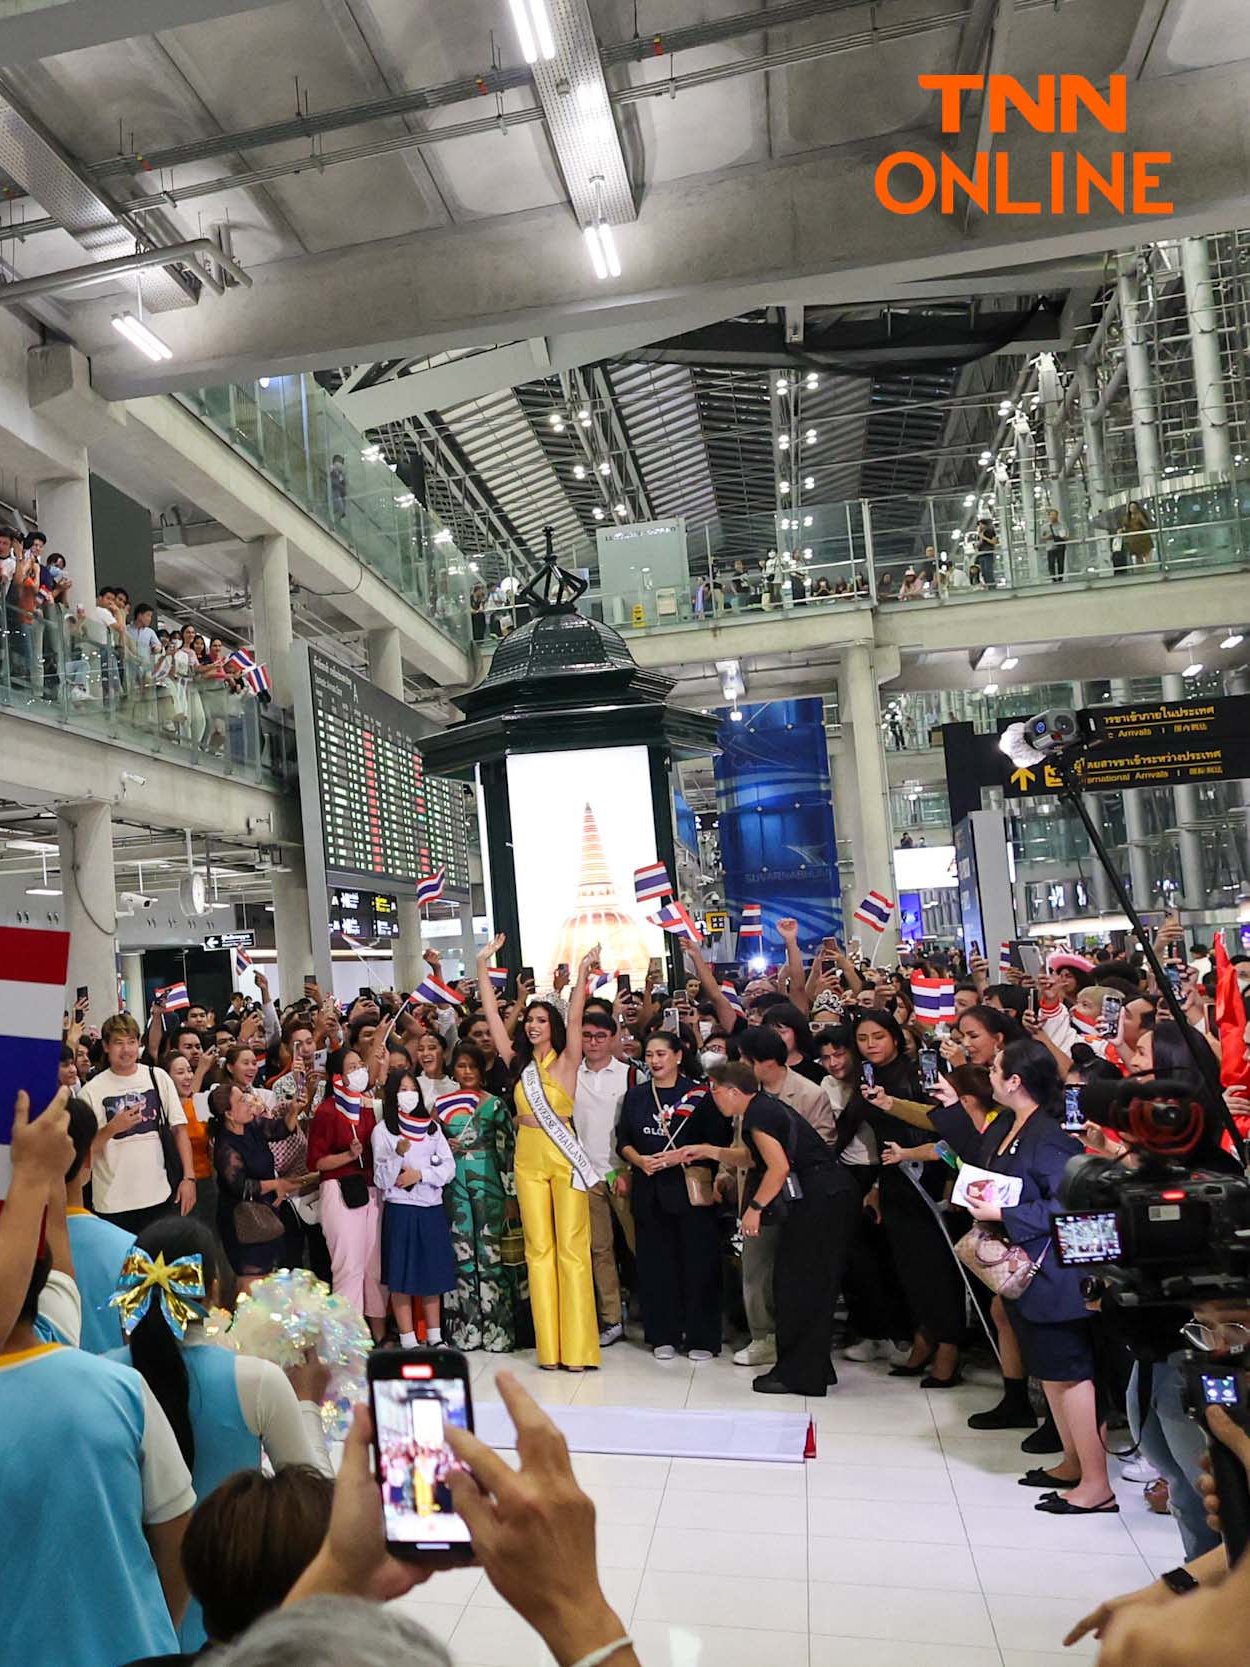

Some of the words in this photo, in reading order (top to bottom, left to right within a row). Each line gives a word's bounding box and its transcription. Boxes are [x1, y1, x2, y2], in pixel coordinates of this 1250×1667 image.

[1103, 706, 1214, 724] ารขาเข้าภายในประเทศ
[1118, 728, 1151, 738] Arrivals
[1086, 773, 1130, 784] ernational
[1135, 769, 1169, 780] Arrivals
[525, 1069, 536, 1086] MISS
[530, 1090, 558, 1130] UNIVERSE
[554, 1126, 587, 1168] THAILAND
